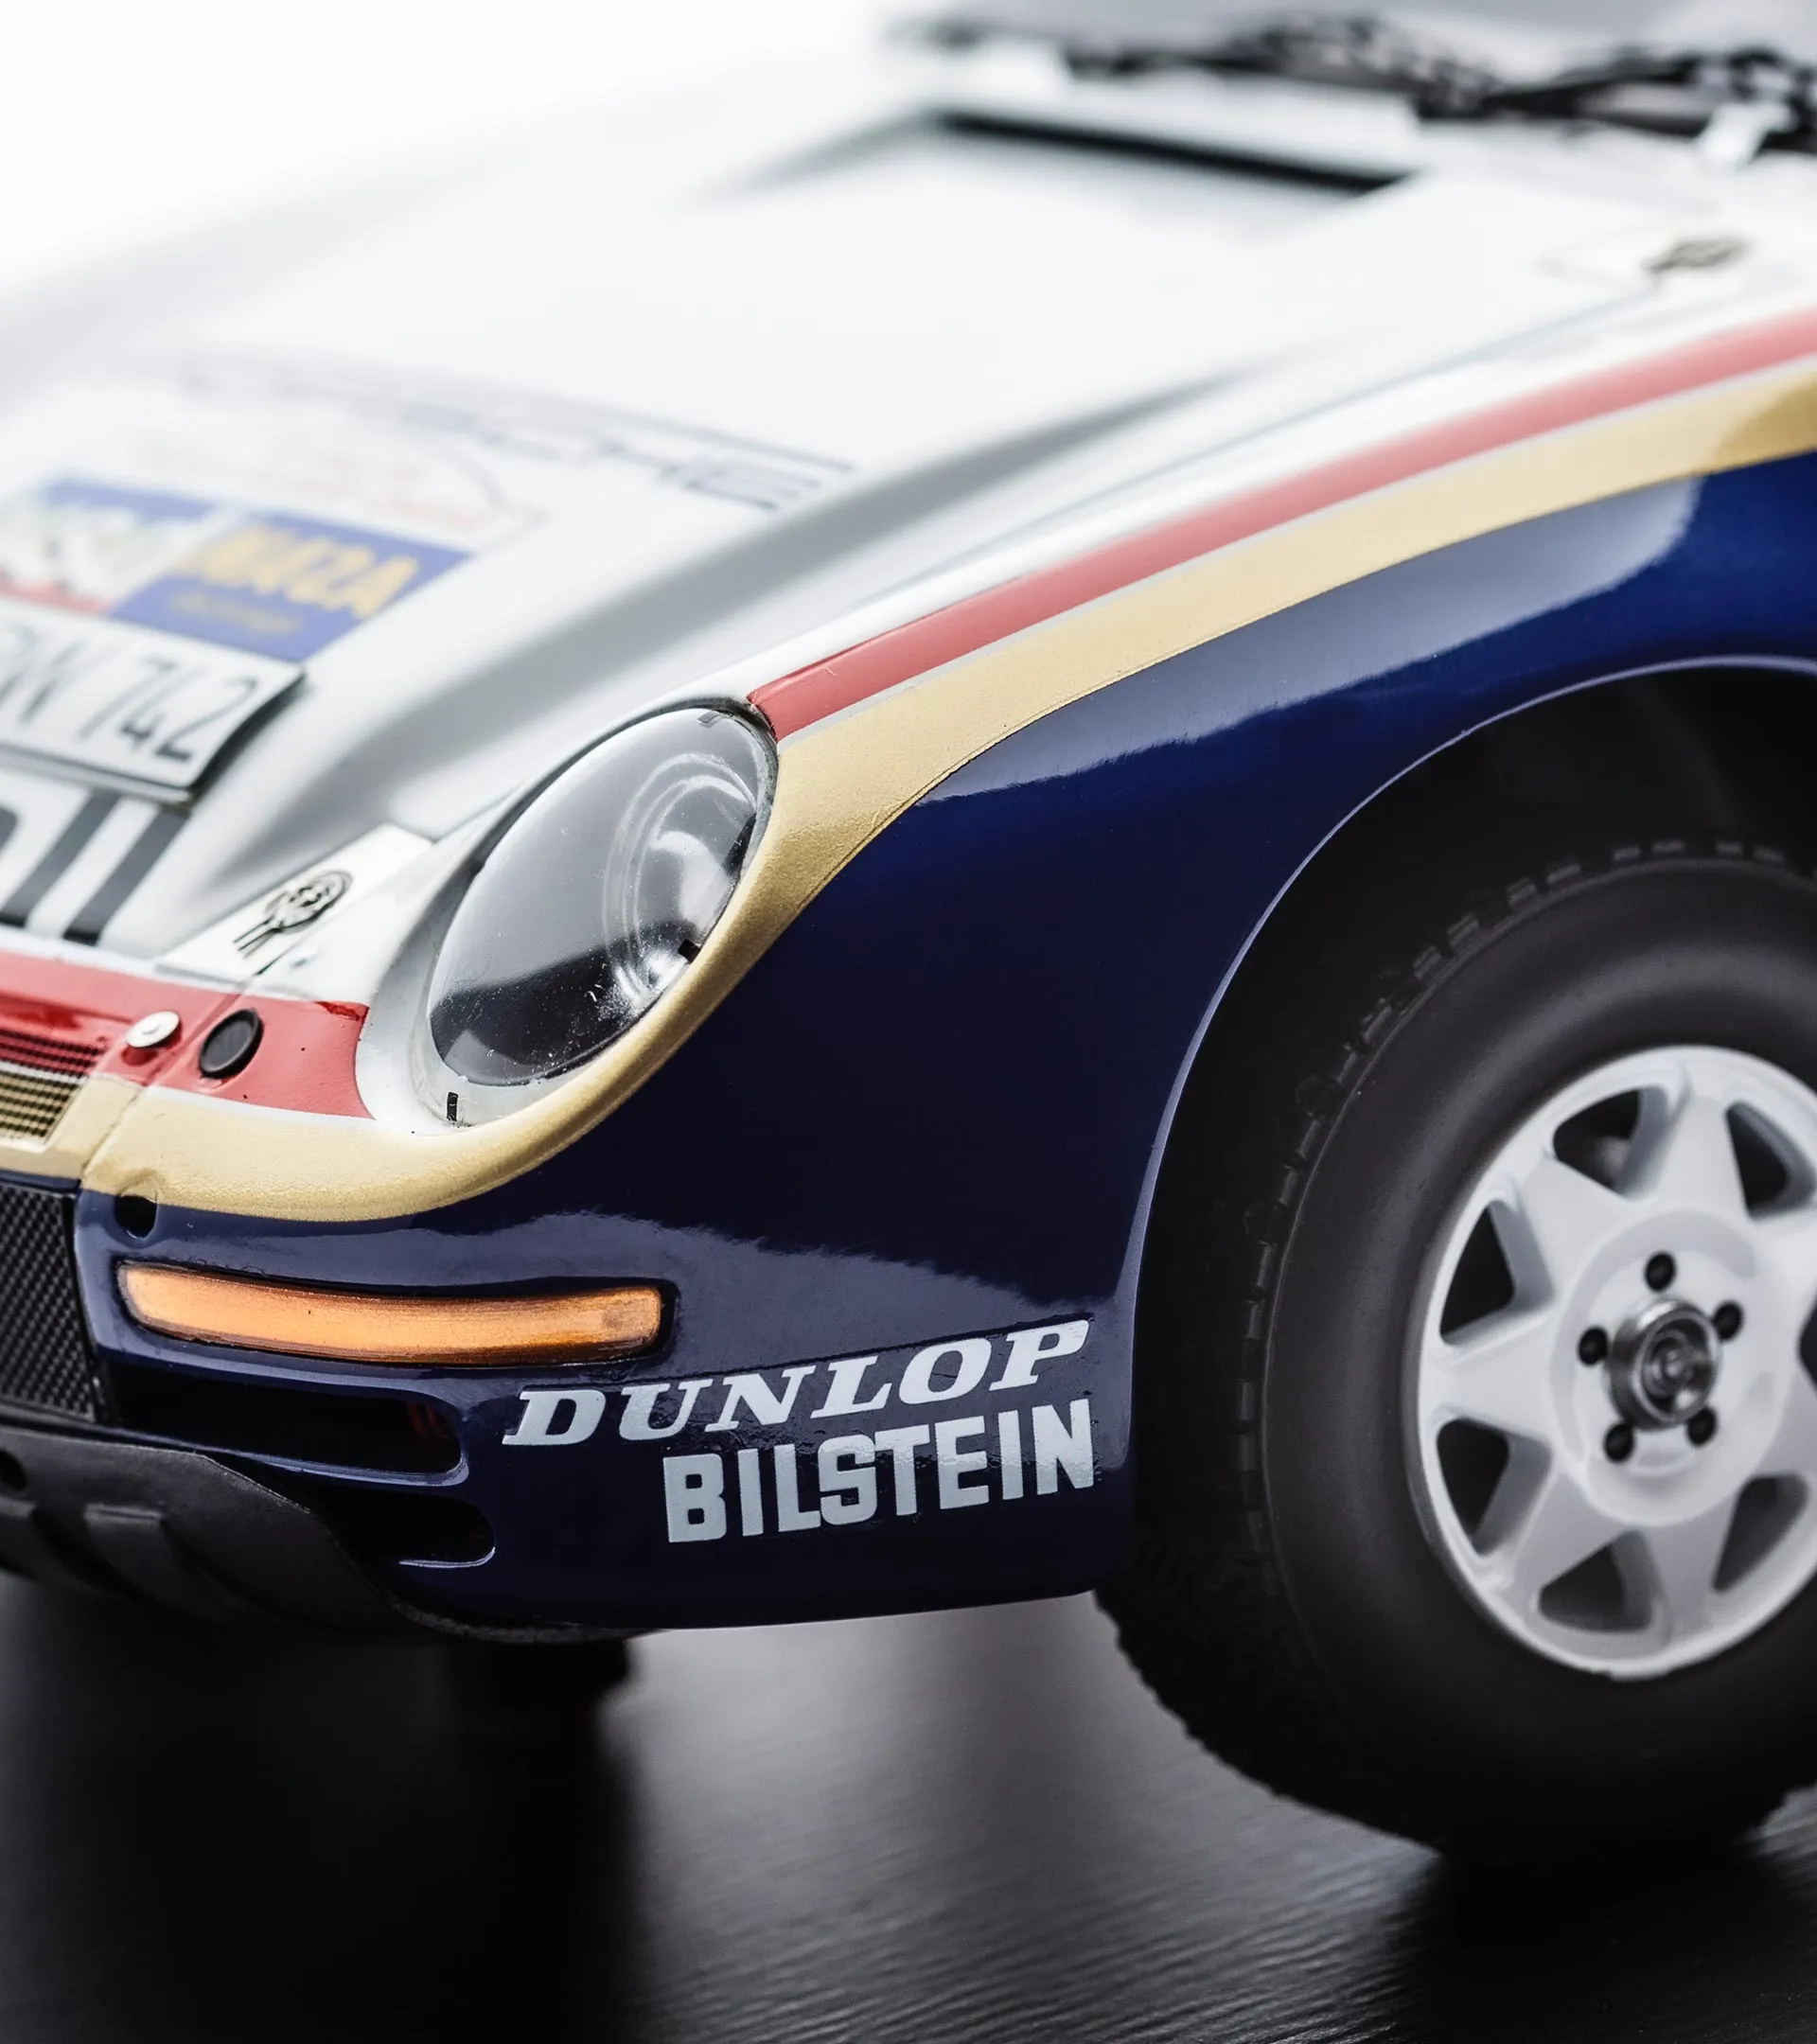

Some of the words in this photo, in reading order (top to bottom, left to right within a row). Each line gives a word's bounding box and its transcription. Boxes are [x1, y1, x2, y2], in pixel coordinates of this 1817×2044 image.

[76, 652, 259, 763] 742
[501, 1318, 1091, 1447] DUNLOP
[662, 1397, 1094, 1543] BILSTEIN
